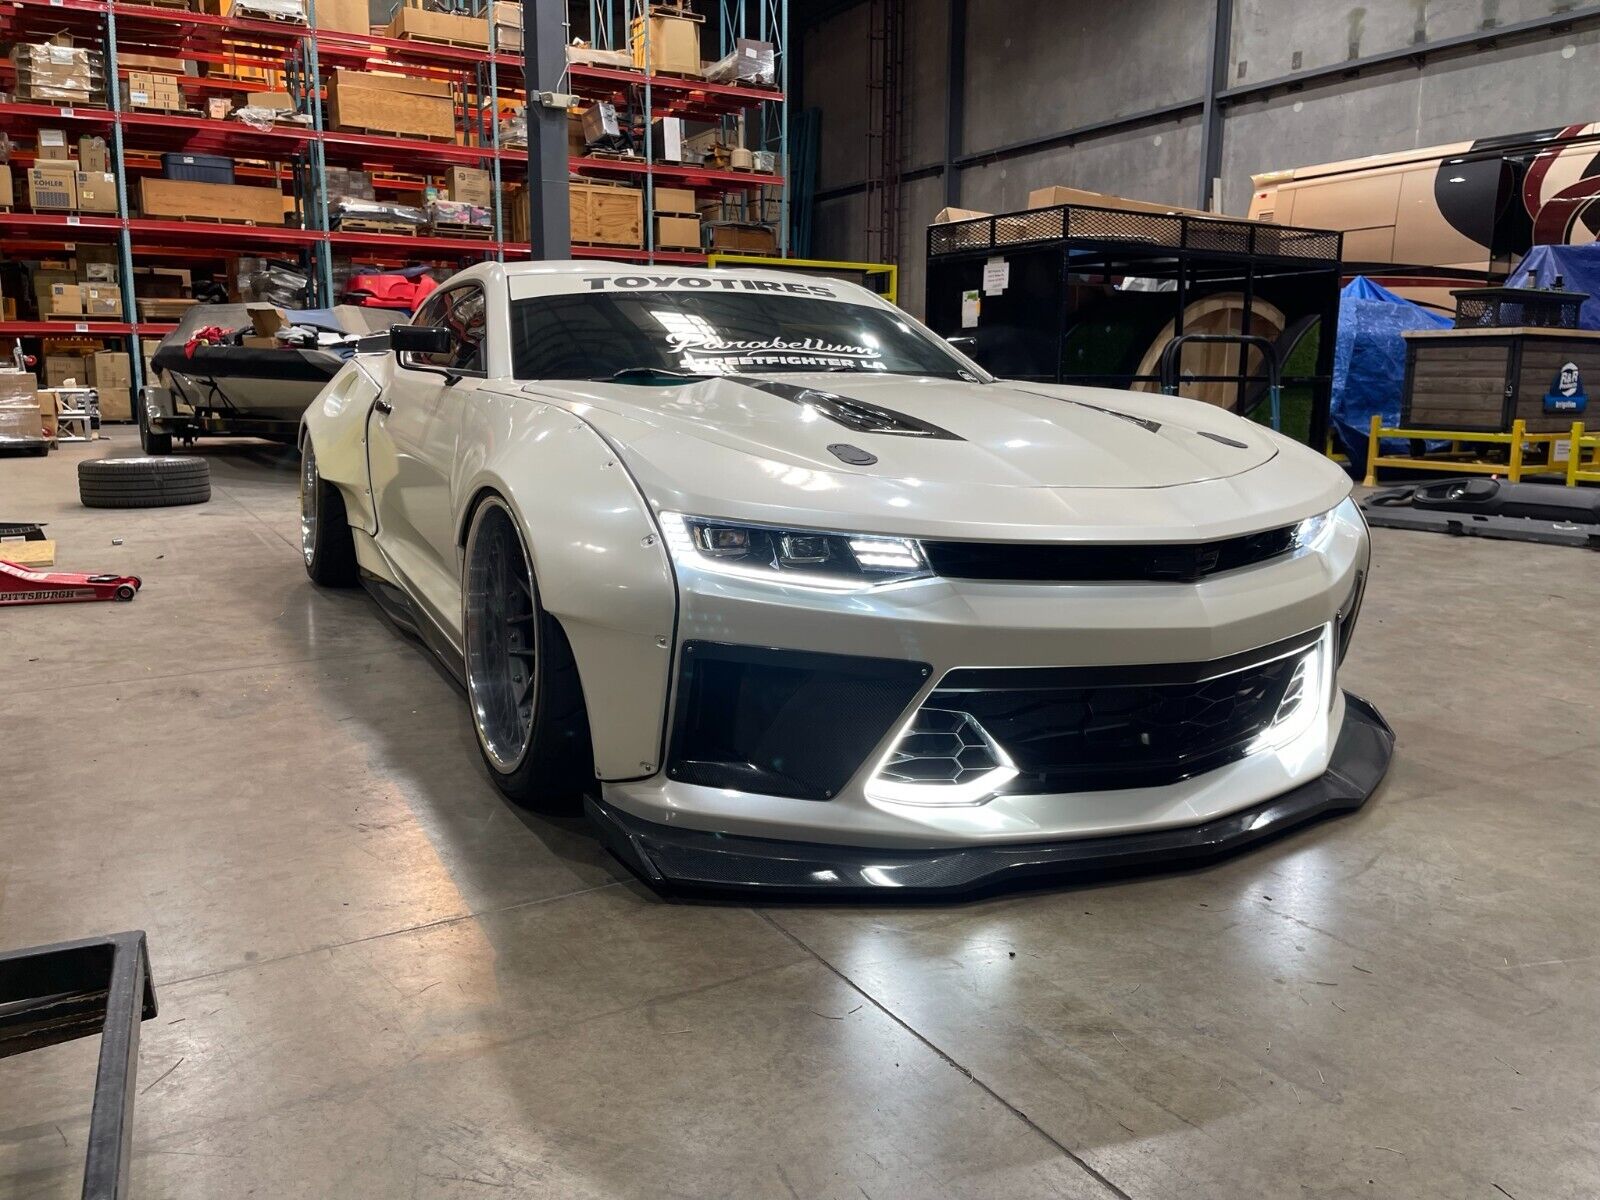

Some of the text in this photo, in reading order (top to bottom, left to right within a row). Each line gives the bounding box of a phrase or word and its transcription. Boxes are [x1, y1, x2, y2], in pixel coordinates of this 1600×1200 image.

[665, 333, 881, 359] Parabellum
[860, 360, 887, 370] LA
[1, 590, 75, 600] PITTSBURGH
